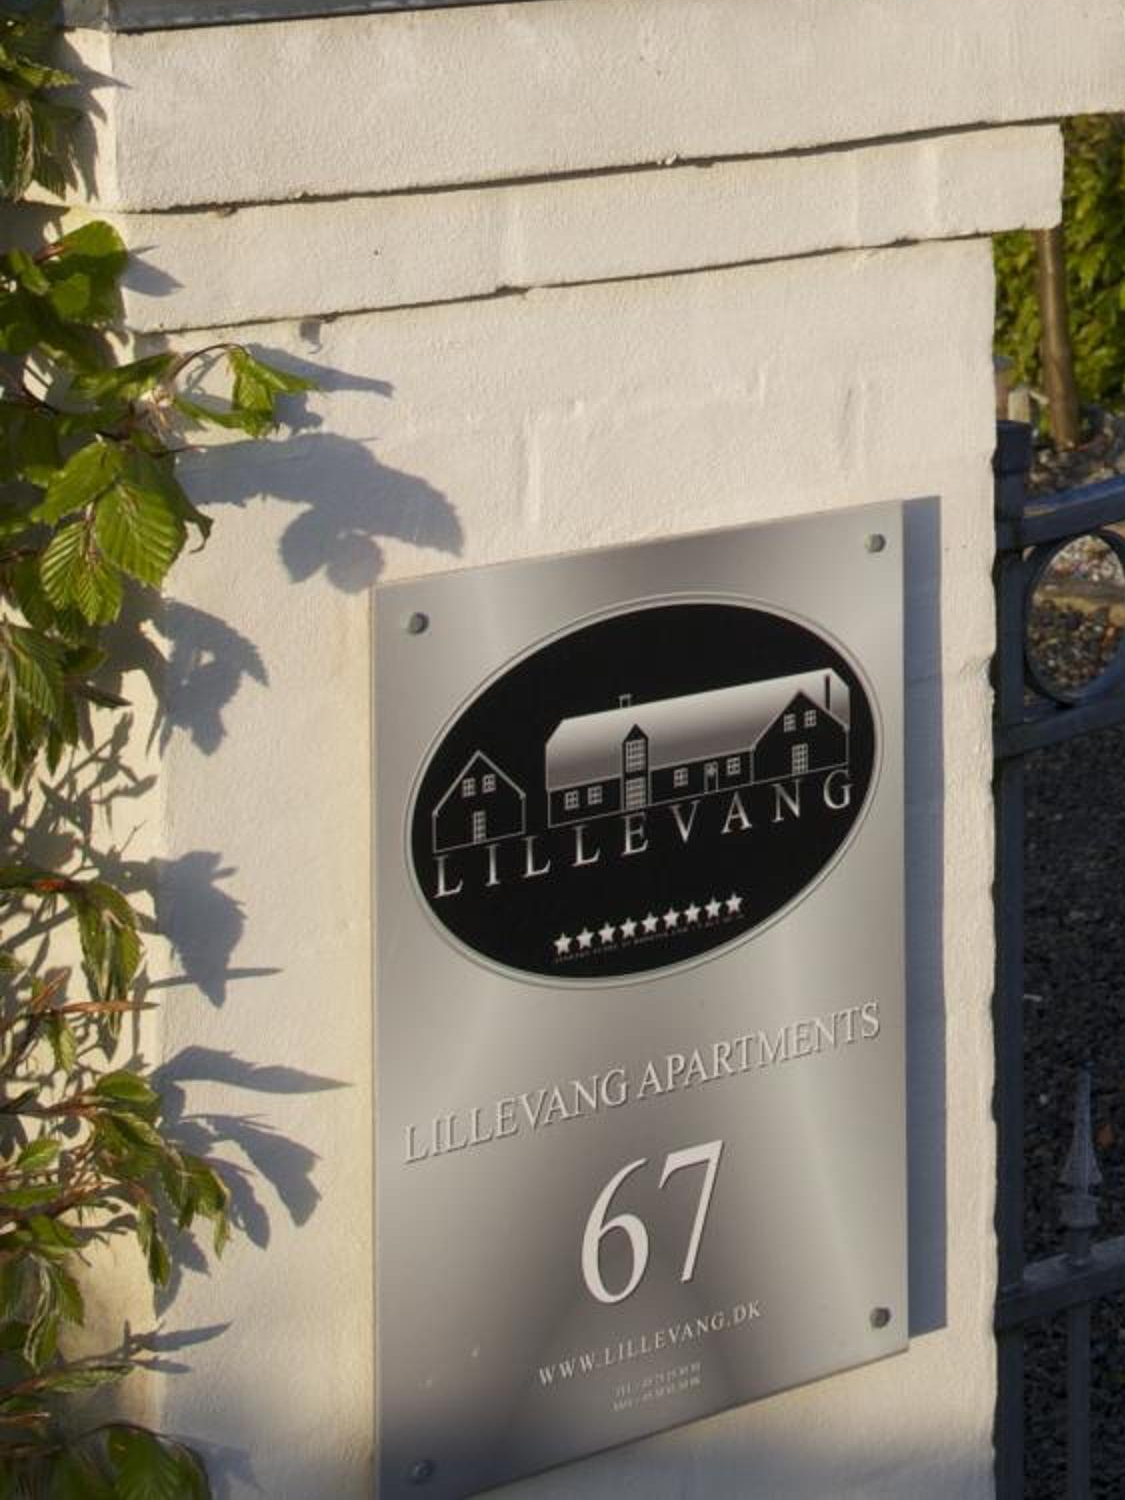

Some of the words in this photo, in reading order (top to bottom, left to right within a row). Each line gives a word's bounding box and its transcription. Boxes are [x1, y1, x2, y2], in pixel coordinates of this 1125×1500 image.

[433, 768, 853, 899] LILLEVANG
[402, 1068, 629, 1164] LILLEVANG
[636, 1002, 882, 1100] APARTMENTS
[580, 1139, 725, 1305] 67
[537, 1299, 763, 1387] WWW.LILLEVANG.DK
